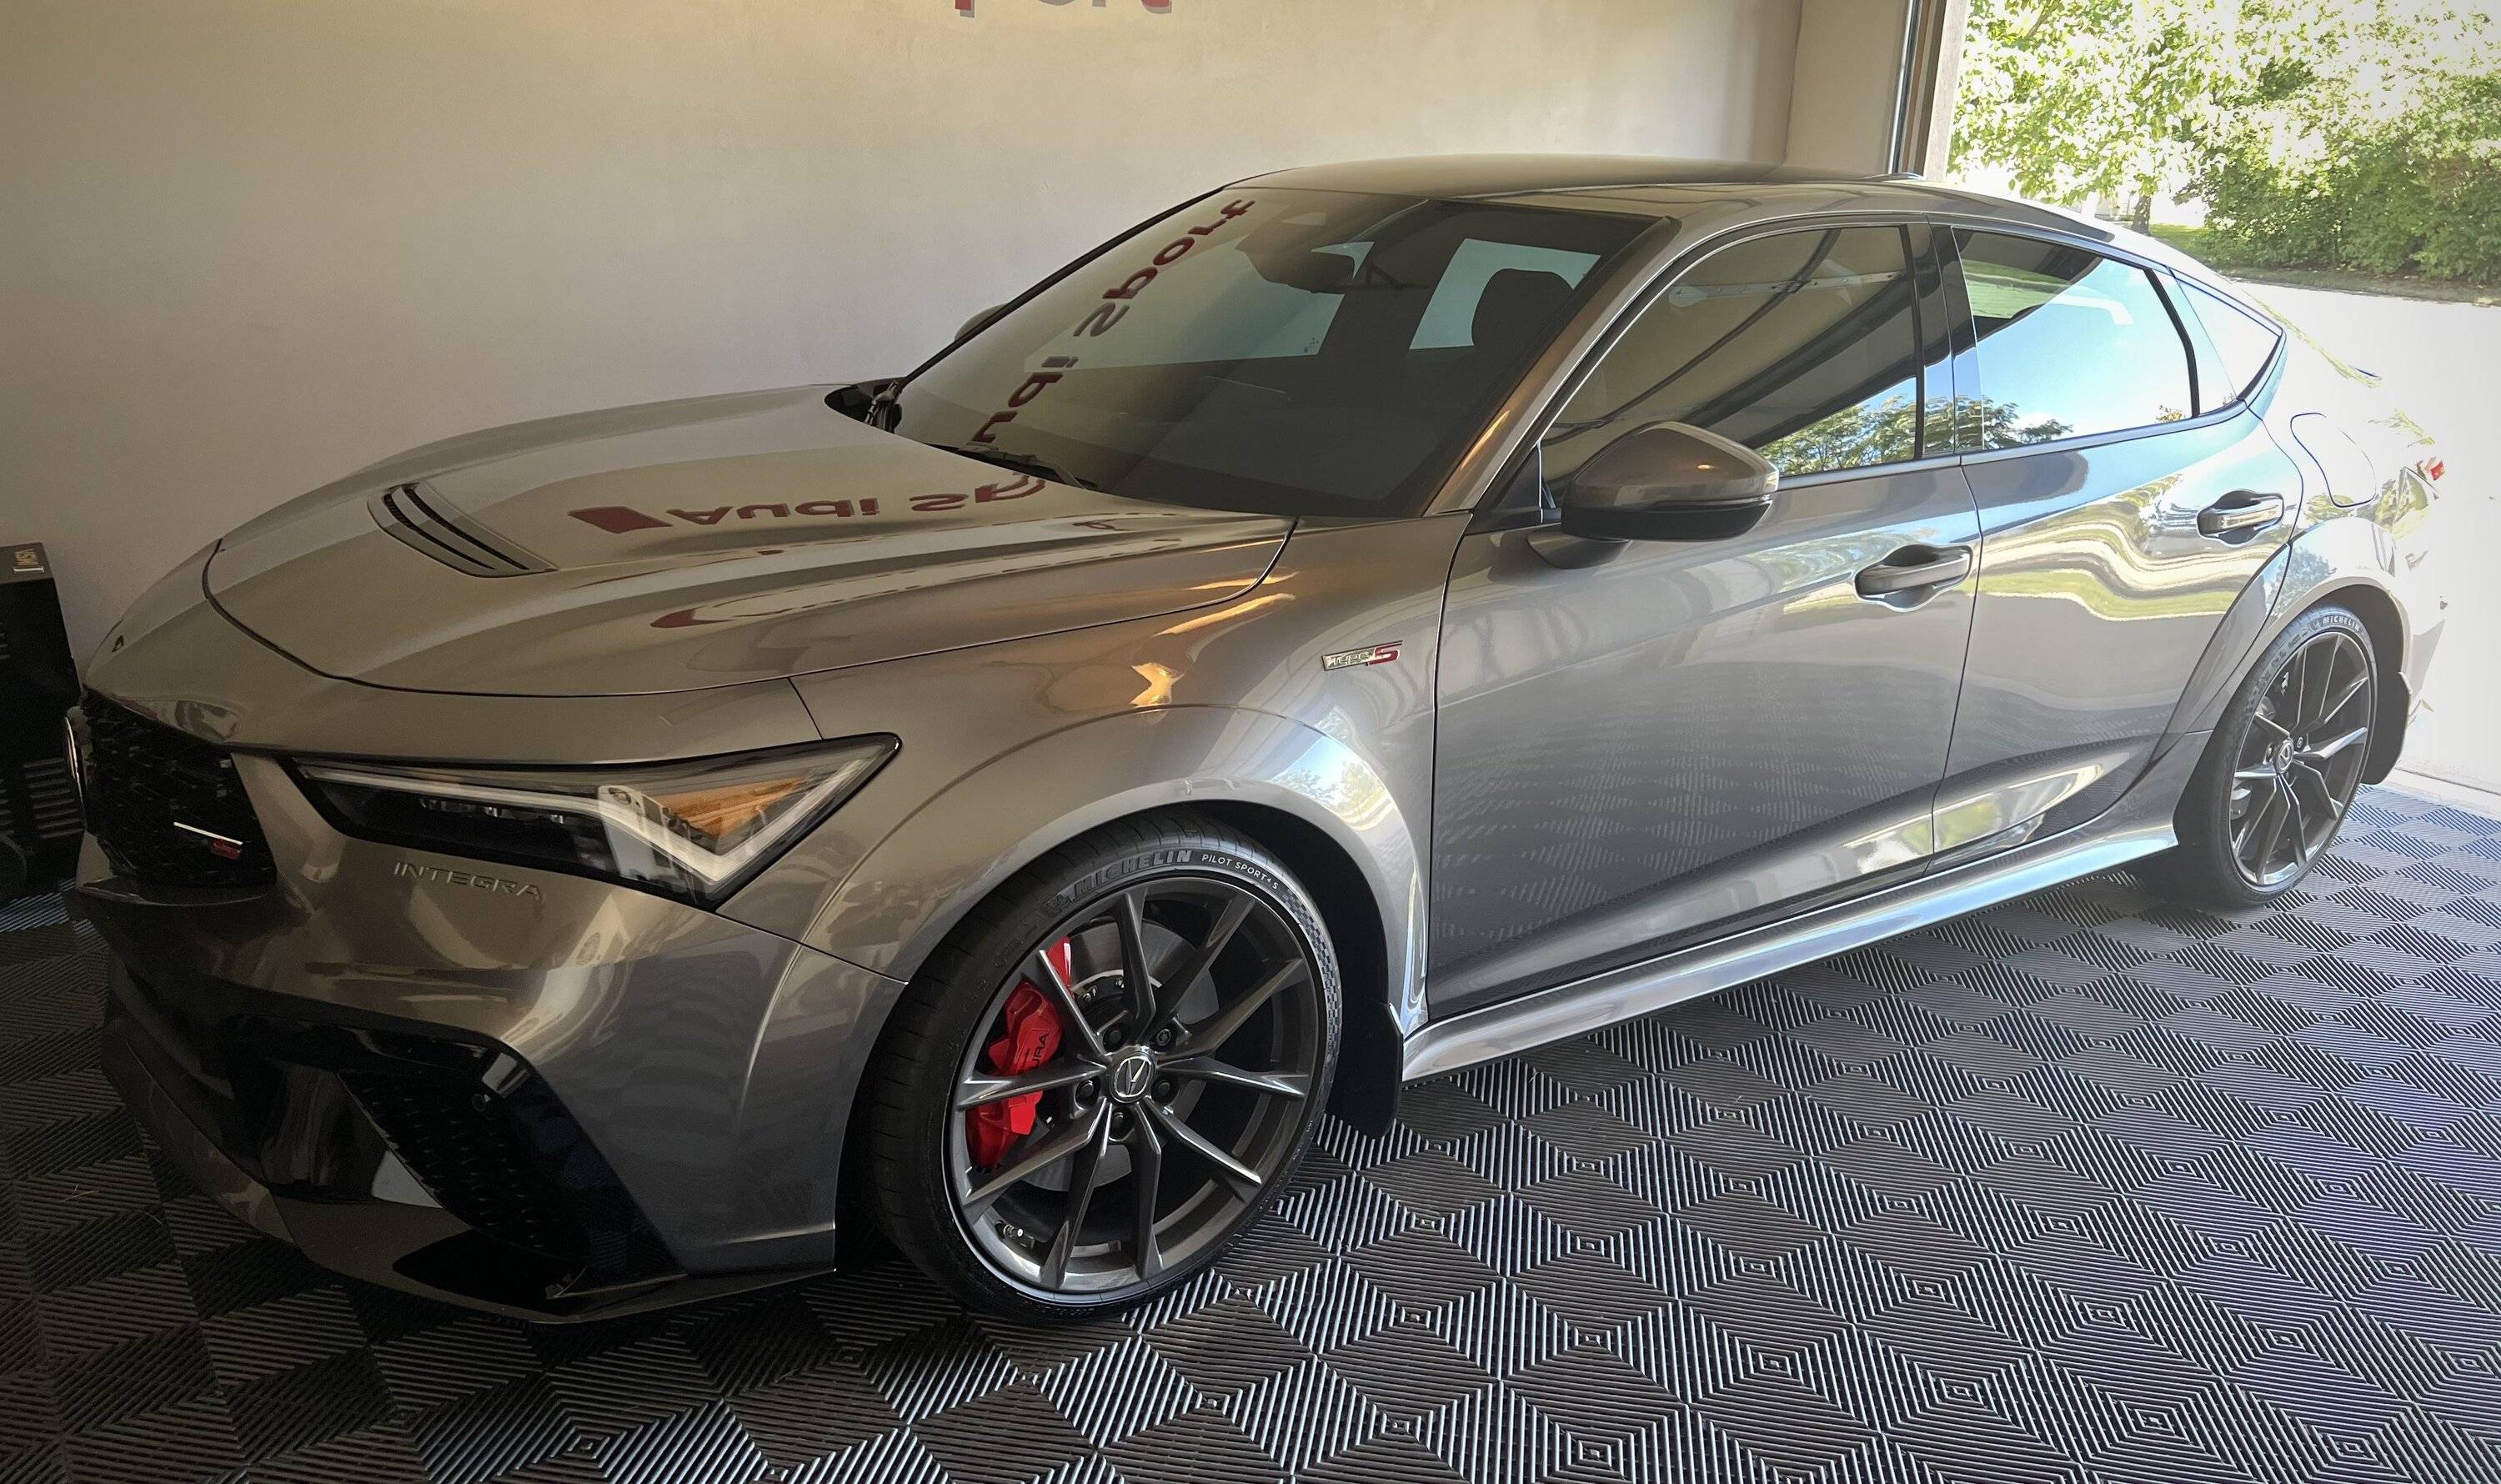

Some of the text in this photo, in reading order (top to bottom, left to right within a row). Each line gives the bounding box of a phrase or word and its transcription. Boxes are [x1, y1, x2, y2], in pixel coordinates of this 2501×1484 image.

[2322, 614, 2360, 632] MICHELIN
[1367, 640, 1403, 667] S
[393, 861, 541, 900] INTEGRA
[1073, 850, 1192, 899] MICHELIN
[1201, 854, 1233, 866] PILOT
[1271, 881, 1280, 890] S
